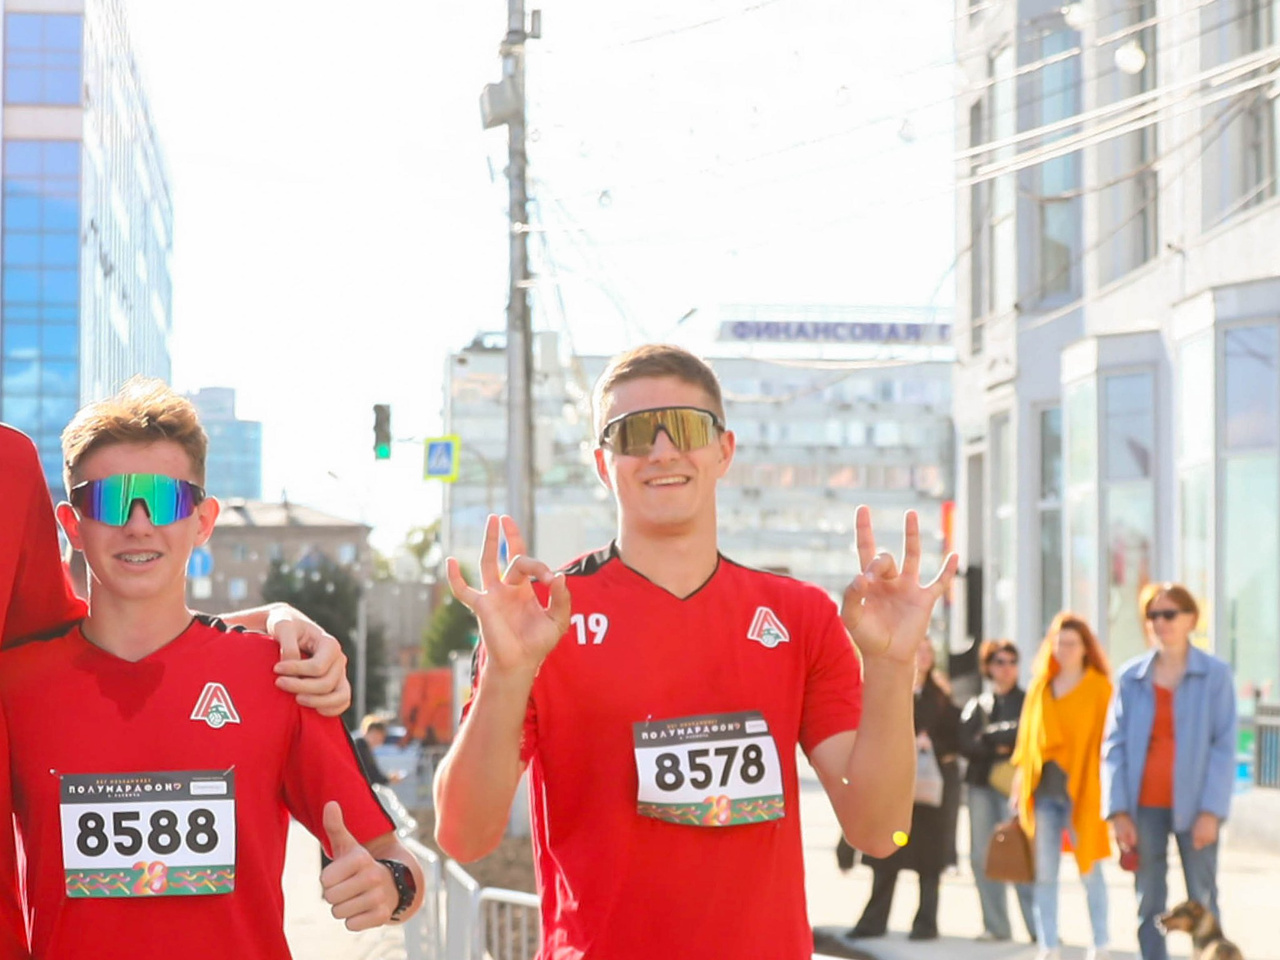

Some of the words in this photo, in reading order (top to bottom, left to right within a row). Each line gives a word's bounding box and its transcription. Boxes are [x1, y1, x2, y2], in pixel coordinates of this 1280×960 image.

[731, 321, 922, 341] ФИНАНСОВАЯ
[570, 612, 609, 645] 19
[655, 743, 766, 792] 8578
[69, 783, 173, 794] ПОЛУМАРАФОН
[76, 808, 219, 858] 8588
[131, 860, 169, 895] 28
